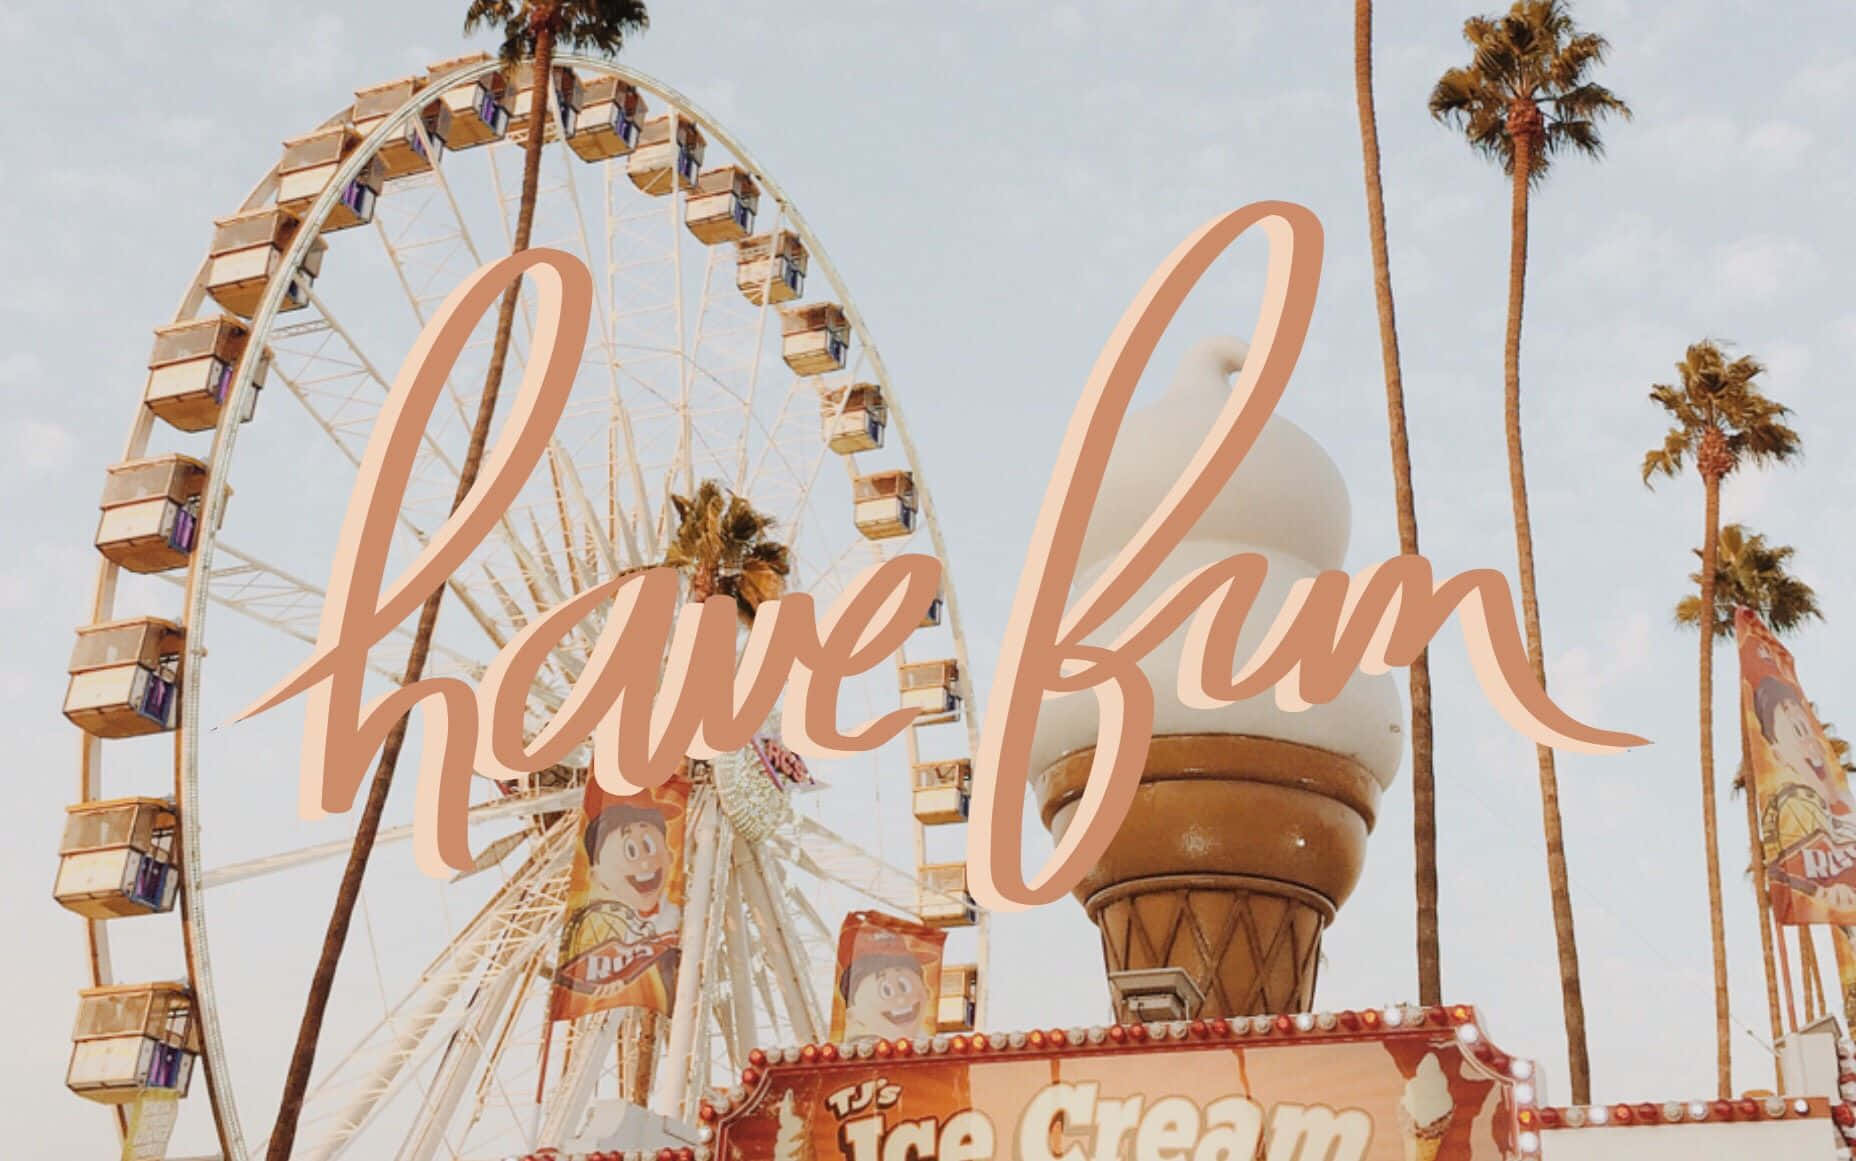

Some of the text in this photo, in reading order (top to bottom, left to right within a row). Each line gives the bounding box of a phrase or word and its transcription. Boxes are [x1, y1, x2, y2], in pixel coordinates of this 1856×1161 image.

[827, 1079, 901, 1119] TJ's
[842, 1080, 1373, 1161] Ice Cream
